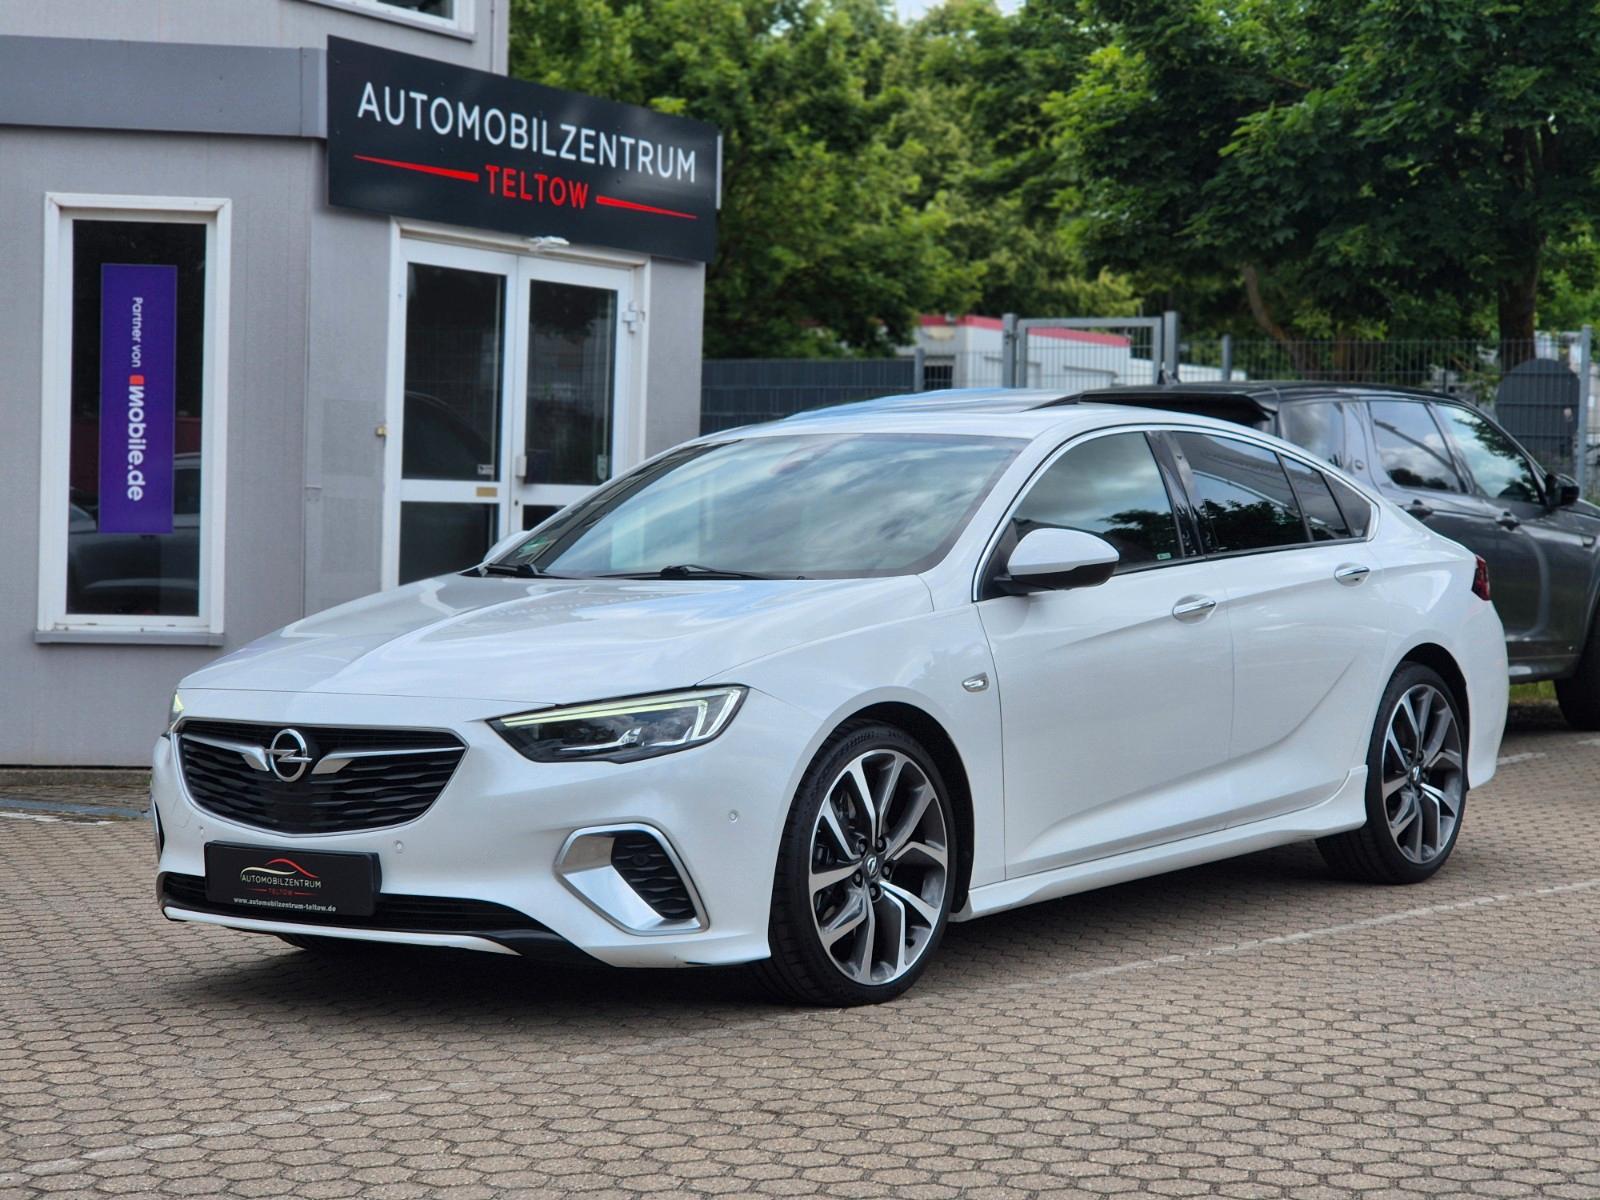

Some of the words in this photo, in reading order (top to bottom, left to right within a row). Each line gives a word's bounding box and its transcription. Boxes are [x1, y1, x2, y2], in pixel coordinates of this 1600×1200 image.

[357, 81, 696, 183] AUTOMOBILZENTRUM
[485, 164, 588, 210] TELTOW
[131, 297, 143, 342] Partner
[131, 345, 142, 368] von
[127, 384, 146, 501] mobile.de
[241, 875, 322, 888] AUTOMOBILZENTRUM
[233, 897, 337, 912] www.automobilzentrum-teltow.de
